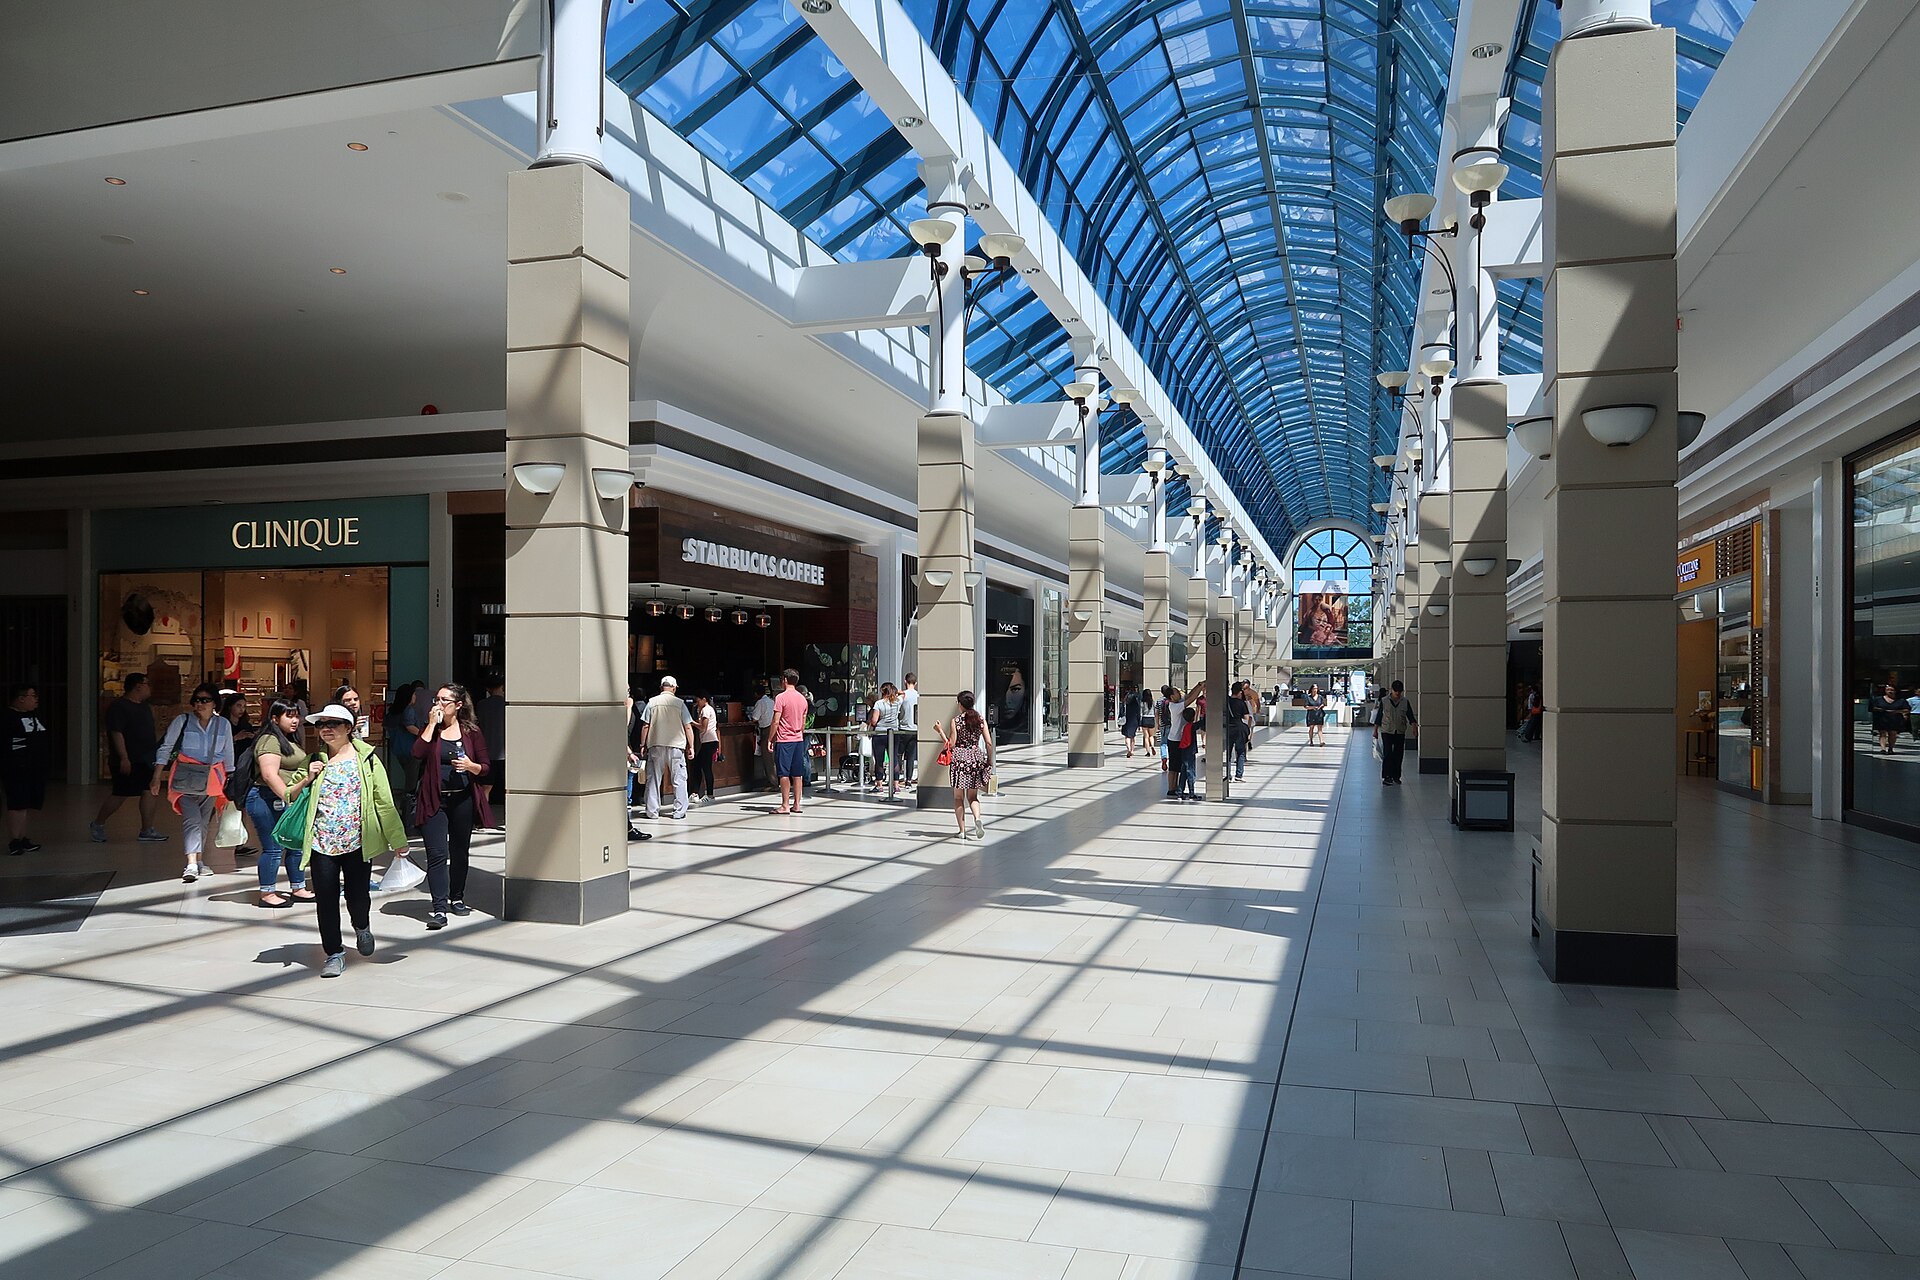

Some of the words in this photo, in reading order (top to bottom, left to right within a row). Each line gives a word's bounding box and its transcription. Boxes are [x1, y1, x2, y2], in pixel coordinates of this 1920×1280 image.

[231, 517, 360, 551] CLINIQUE
[682, 538, 777, 577] STARBUCKS
[777, 558, 825, 586] COFFEE
